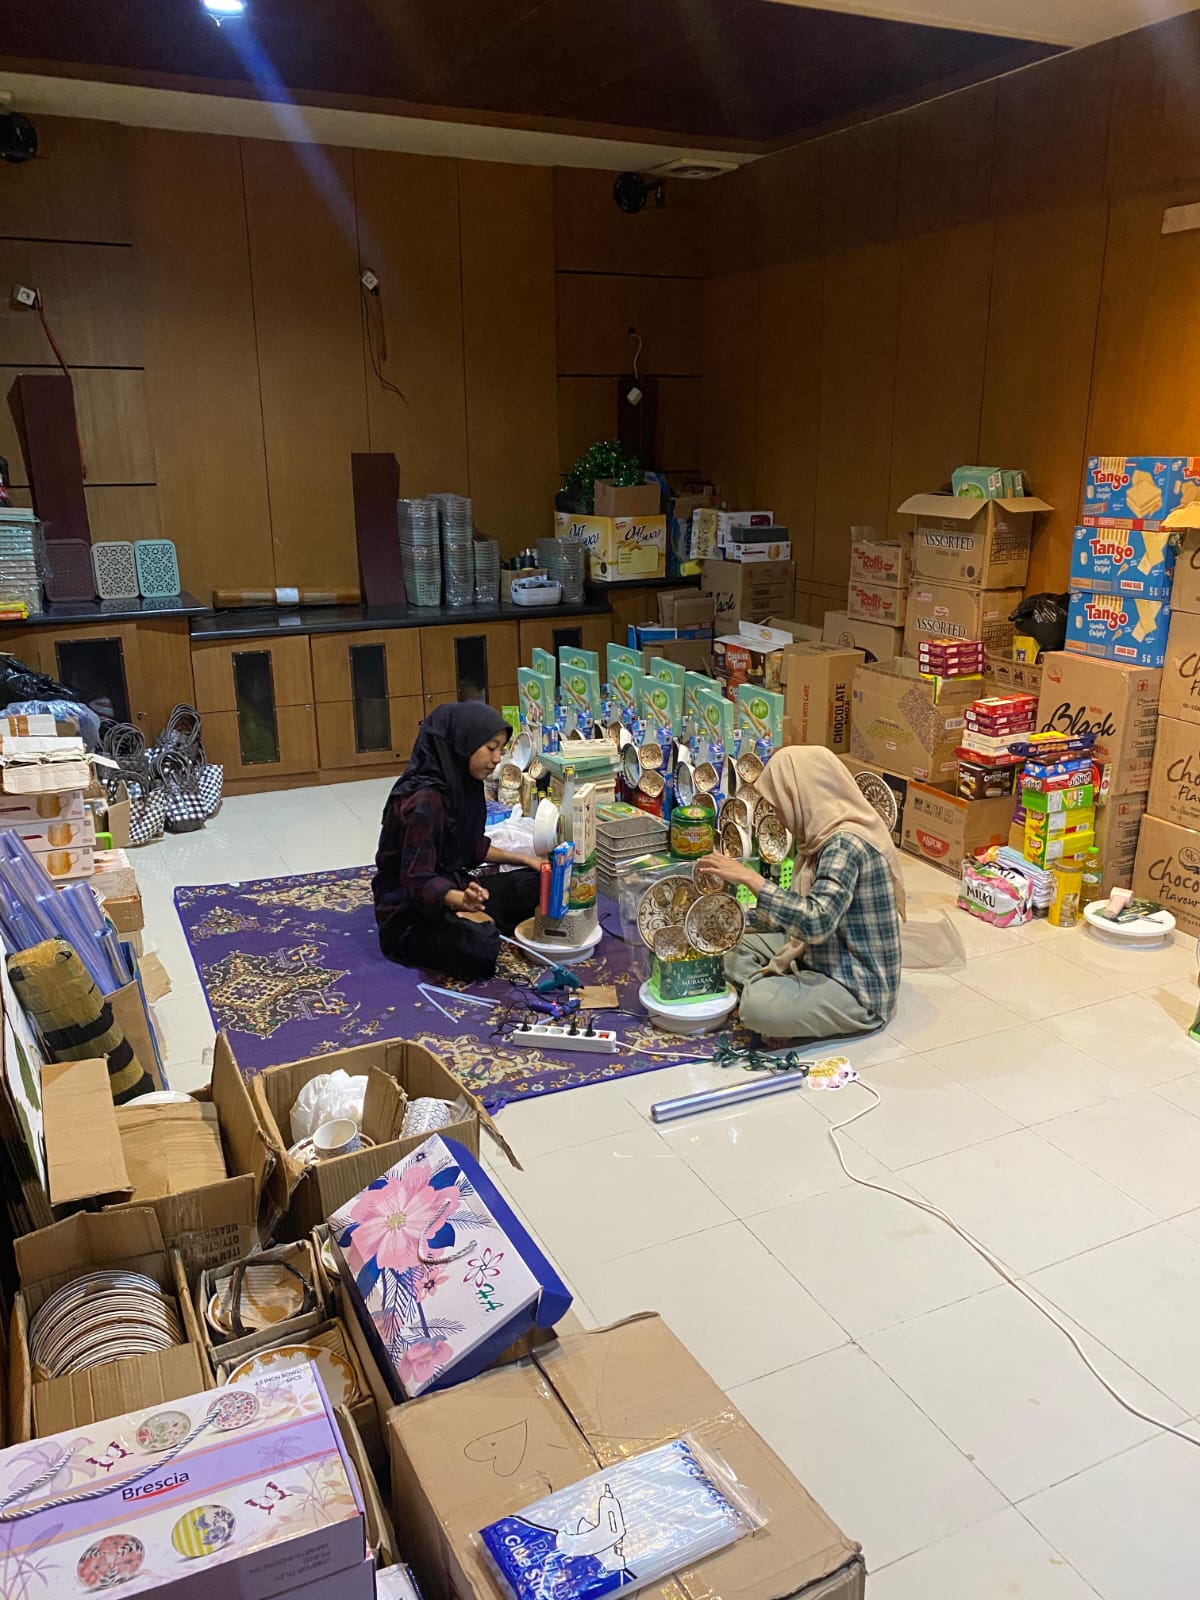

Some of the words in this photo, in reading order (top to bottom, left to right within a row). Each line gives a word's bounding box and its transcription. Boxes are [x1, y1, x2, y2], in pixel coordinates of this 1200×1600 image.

[1092, 470, 1129, 490] Tango
[924, 533, 974, 550] ASSORTED
[1090, 540, 1133, 563] Tango
[917, 617, 966, 637] ASSORTED
[1085, 604, 1128, 629] Tango
[733, 661, 747, 669] Time
[833, 683, 846, 744] CHOCOLATE
[1040, 702, 1116, 736] Black
[923, 834, 942, 849] ASTOR
[966, 885, 996, 908] MILKU
[682, 976, 713, 986] MUBARAK
[121, 1471, 190, 1501] Brescia
[504, 1534, 532, 1569] Glue
